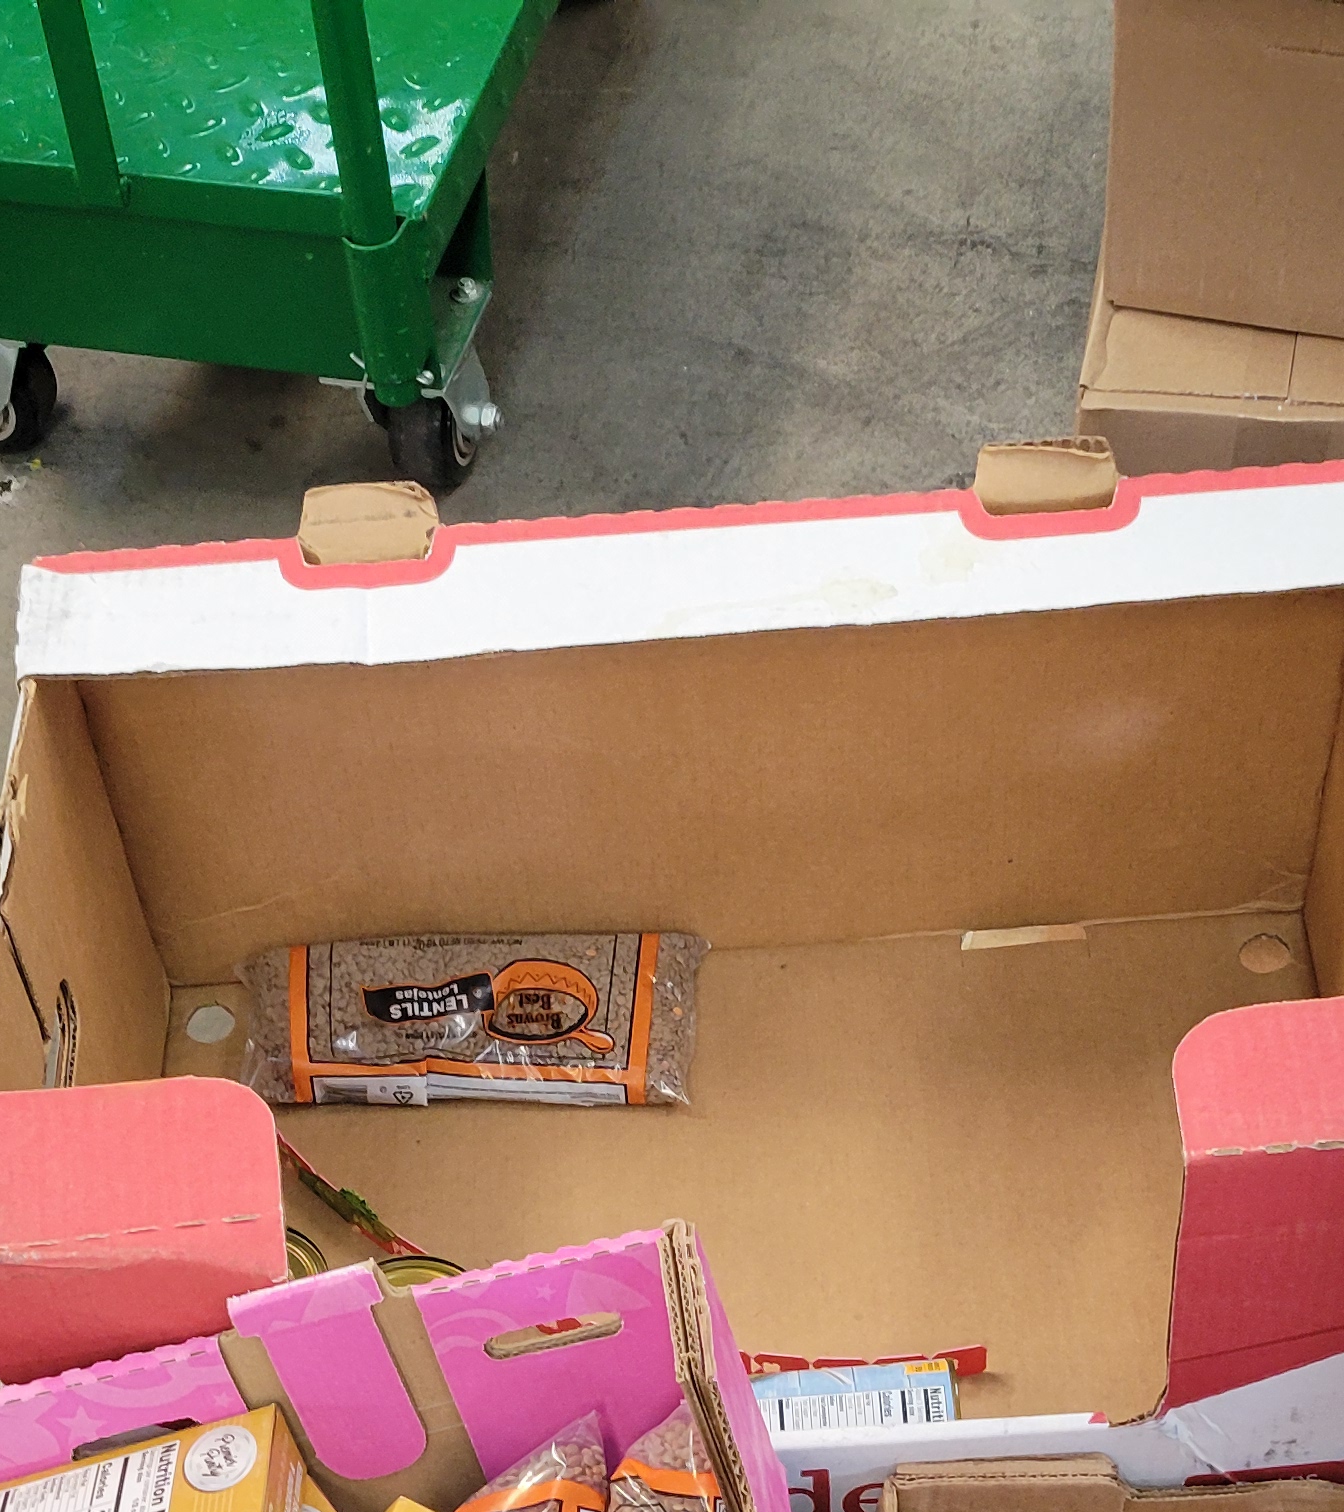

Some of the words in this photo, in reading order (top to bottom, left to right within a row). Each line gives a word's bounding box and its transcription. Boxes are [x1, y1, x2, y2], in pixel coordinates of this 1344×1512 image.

[389, 993, 469, 1020] LENTILS
[395, 982, 459, 1000] Lentejas
[518, 991, 552, 1010] Best
[200, 1447, 225, 1478] Pantry
[213, 1433, 238, 1467] Premier
[95, 1461, 114, 1500] Calories
[151, 1442, 177, 1506] Nutrition
